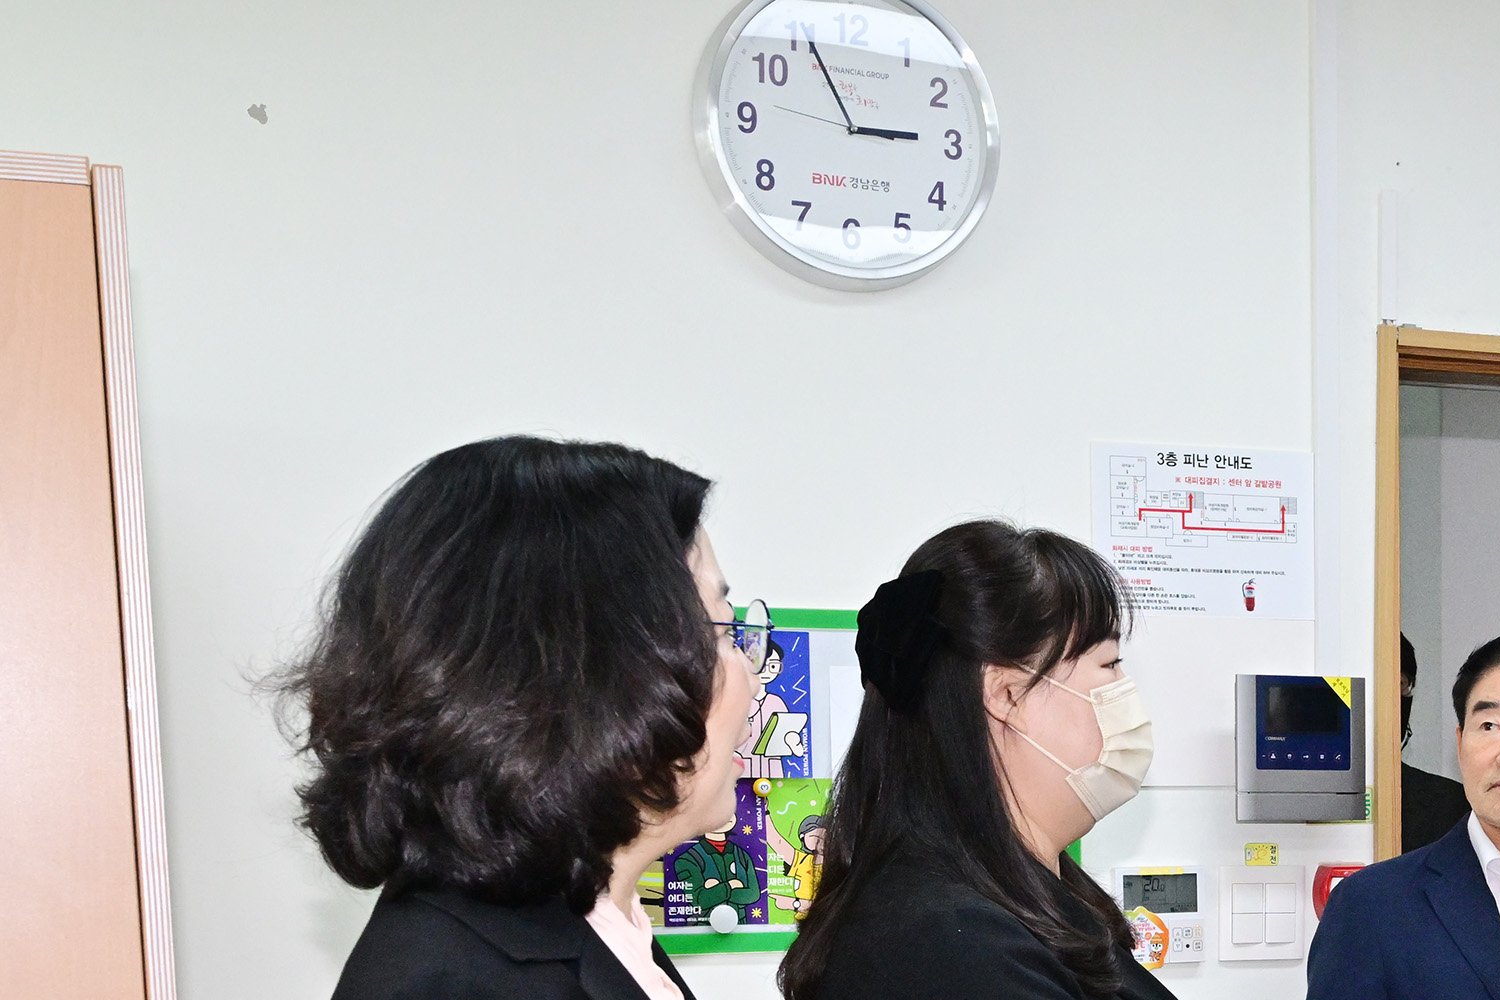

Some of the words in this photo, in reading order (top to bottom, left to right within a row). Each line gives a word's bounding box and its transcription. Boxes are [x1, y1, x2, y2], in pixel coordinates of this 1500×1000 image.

[833, 12, 869, 47] 12
[898, 37, 911, 67] 1
[752, 52, 789, 87] 10
[829, 65, 865, 77] FINANCIAL
[866, 70, 890, 80] GROUP
[929, 77, 949, 109] 2
[737, 101, 758, 134] 9
[943, 129, 963, 160] 3
[755, 158, 775, 191] 8
[812, 172, 847, 188] BNK
[849, 176, 890, 193] 경남은행
[927, 181, 947, 212] 4
[791, 200, 812, 231] 7
[893, 212, 912, 244] 5
[842, 217, 861, 250] 6
[1156, 452, 1178, 467] 3층
[1183, 453, 1209, 469] 피난
[1214, 454, 1253, 470] 안내도
[768, 853, 785, 862] 자는
[768, 865, 785, 874] 디든
[667, 881, 694, 890] 여자는
[768, 877, 794, 886] 재한다
[667, 893, 694, 903] 어디든
[668, 905, 702, 915] 존재한다
